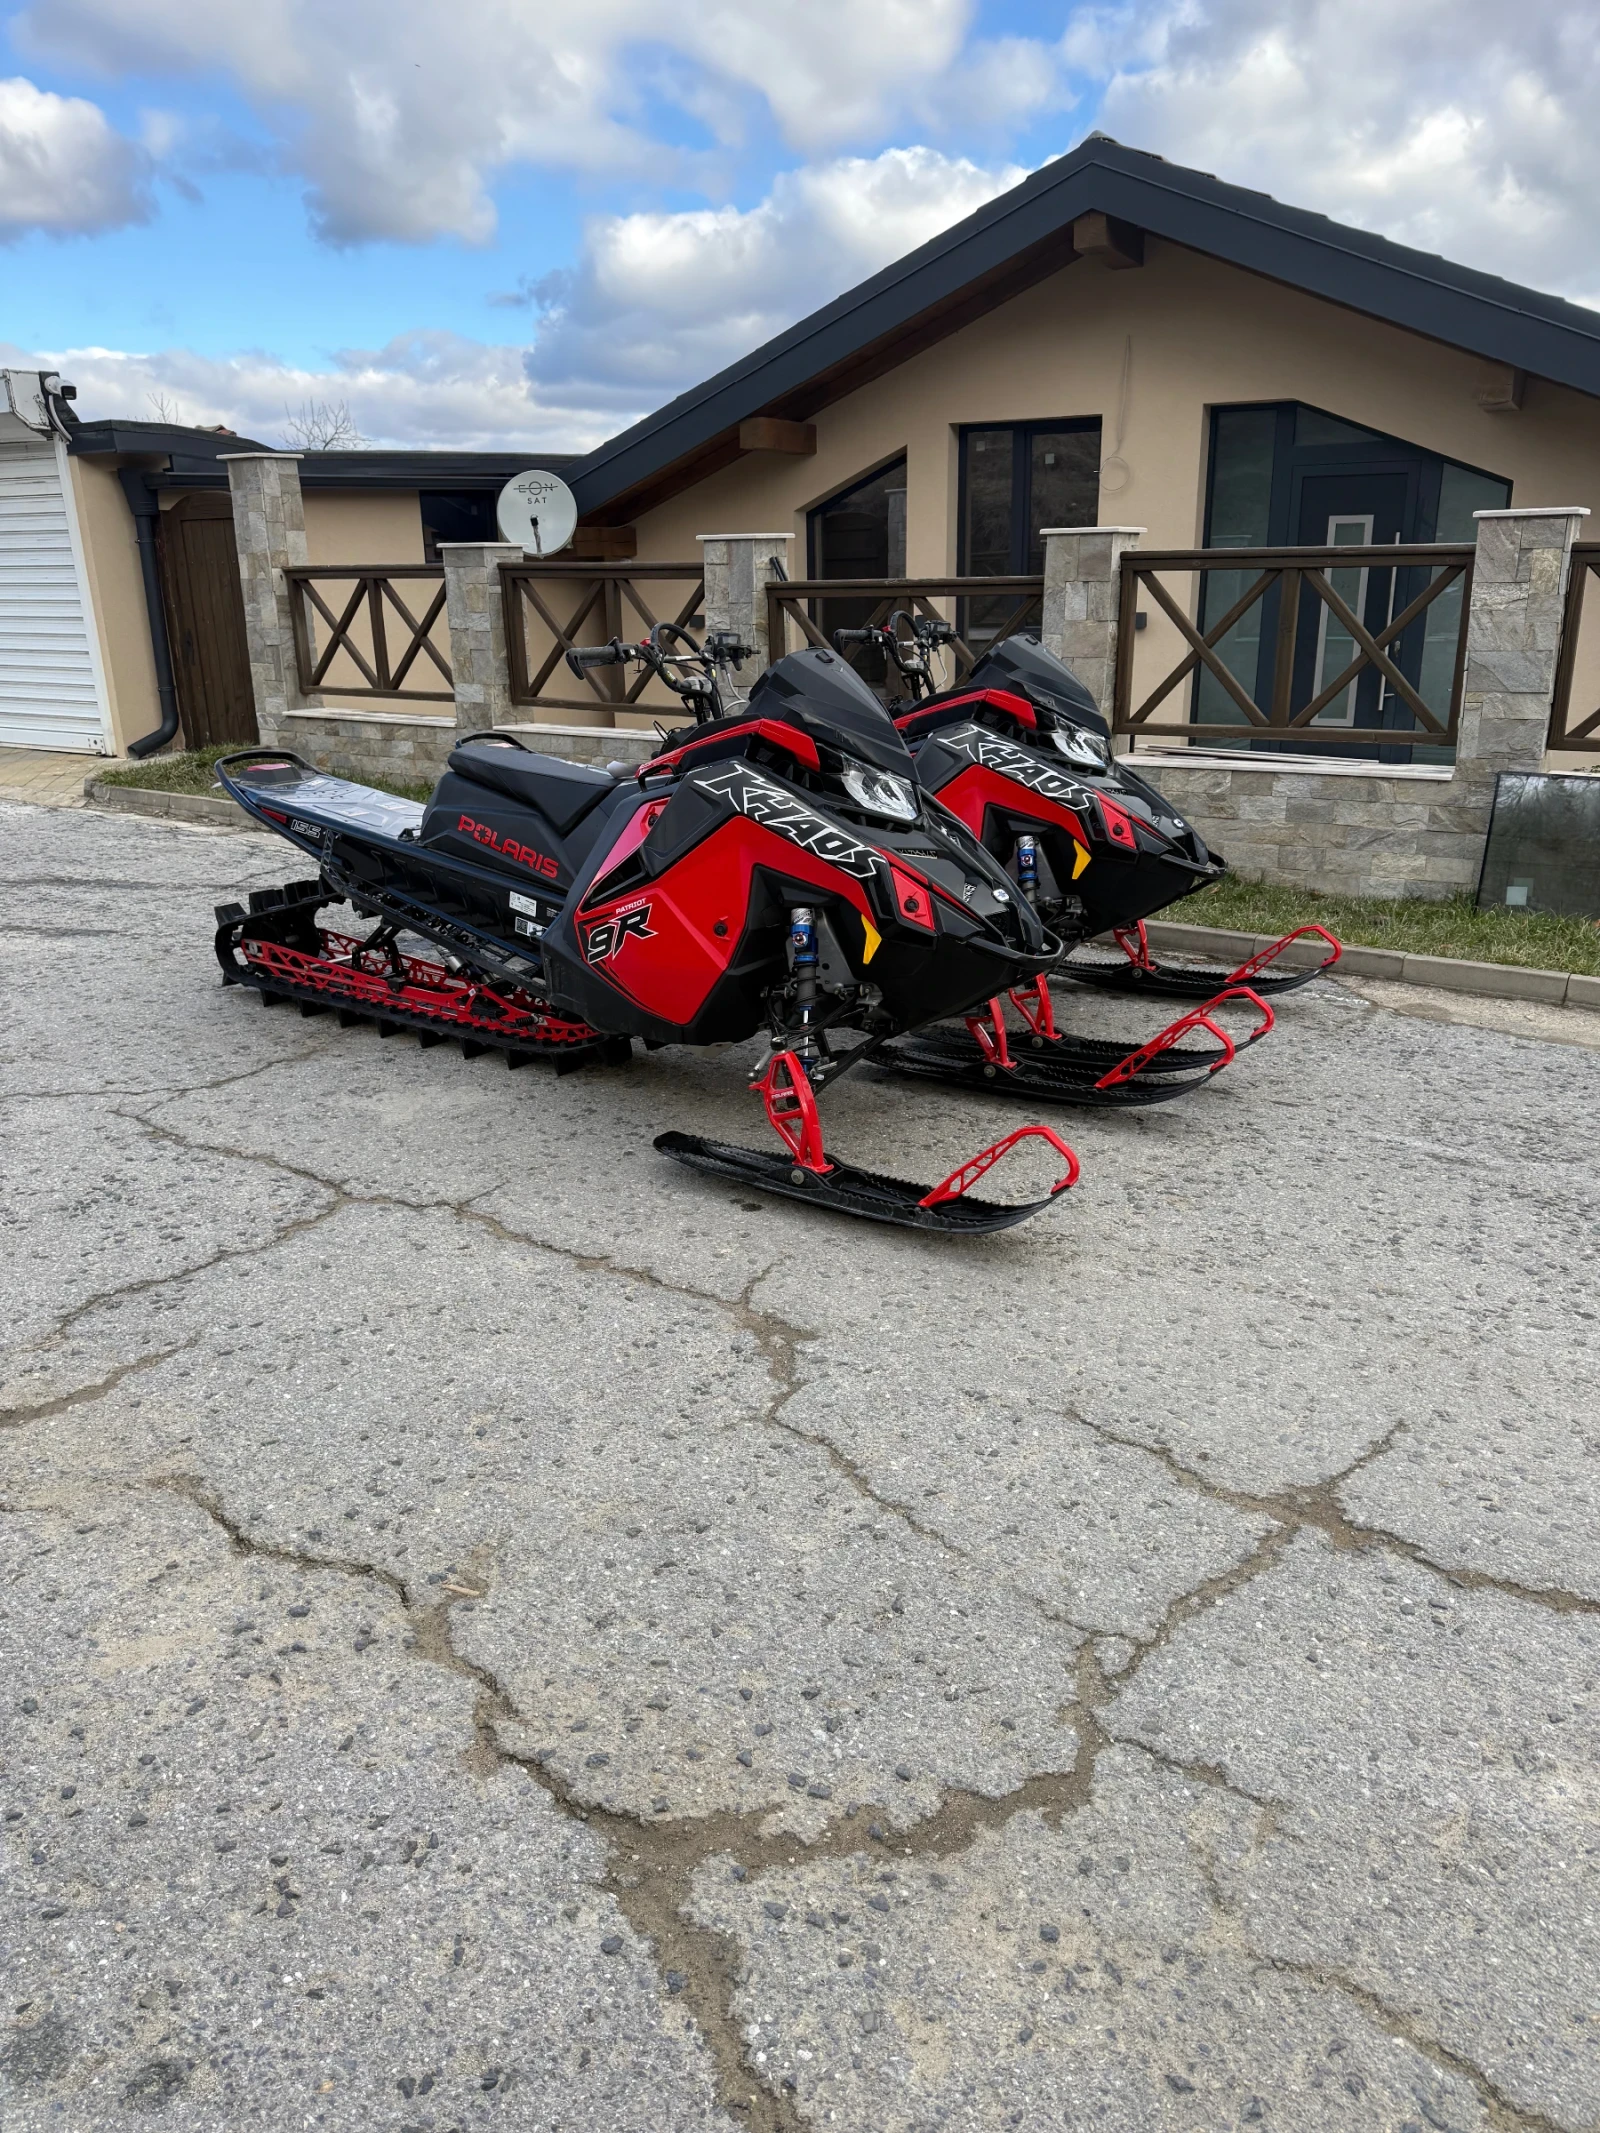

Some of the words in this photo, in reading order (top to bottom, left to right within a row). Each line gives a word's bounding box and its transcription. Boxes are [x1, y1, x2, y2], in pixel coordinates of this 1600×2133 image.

[514, 481, 558, 495] EON
[937, 724, 1098, 810] KHAOS
[457, 814, 559, 878] POLARIS
[693, 764, 887, 878] KHAOS
[588, 903, 659, 964] 9R
[615, 898, 647, 915] PATRIOT
